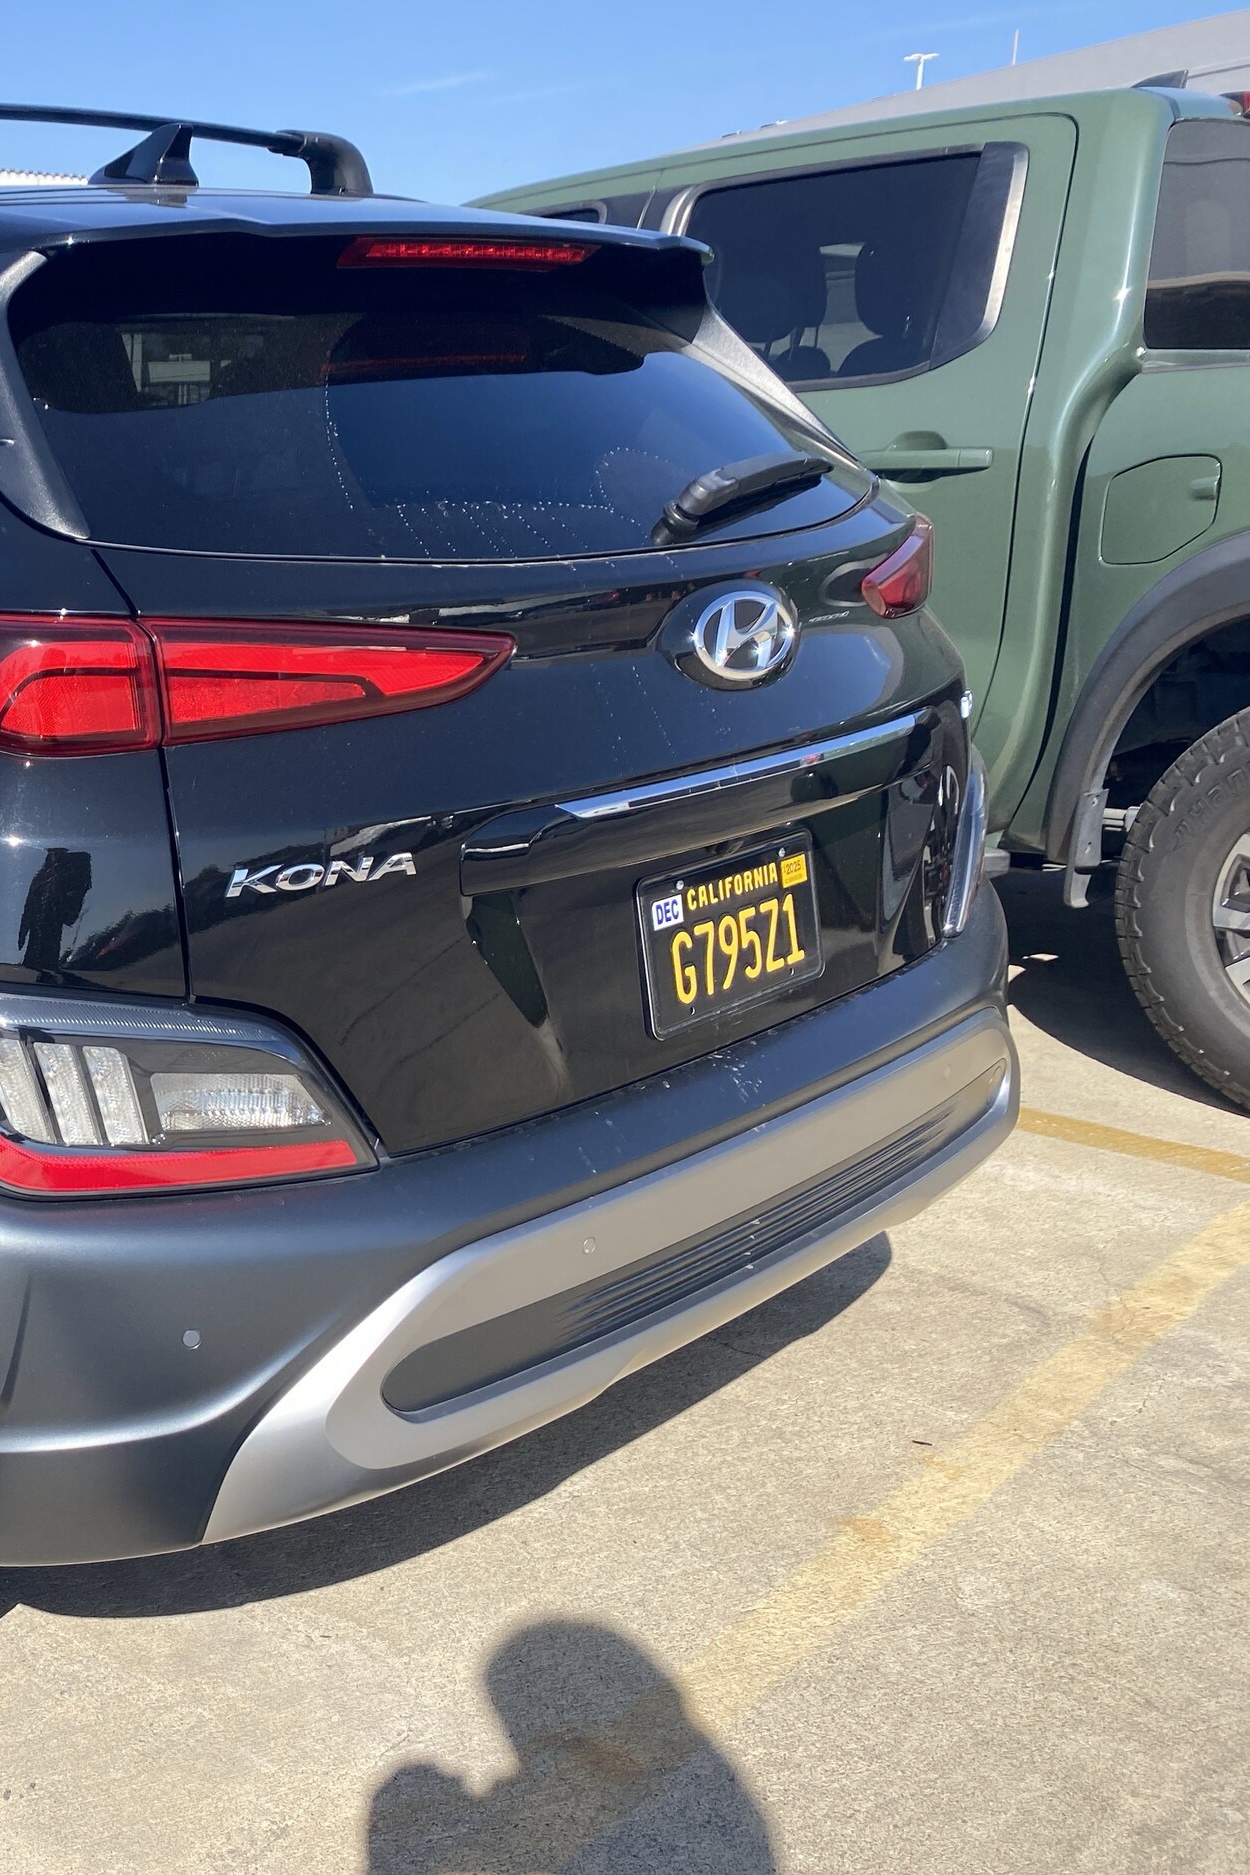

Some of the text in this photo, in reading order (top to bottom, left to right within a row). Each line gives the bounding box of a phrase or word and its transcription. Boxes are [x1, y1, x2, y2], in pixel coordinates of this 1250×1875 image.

[225, 852, 418, 898] KONA
[686, 862, 778, 911] CALIFORNIA
[785, 859, 802, 876] 2025
[655, 898, 680, 926] DEC
[670, 893, 806, 1005] G795Z1
